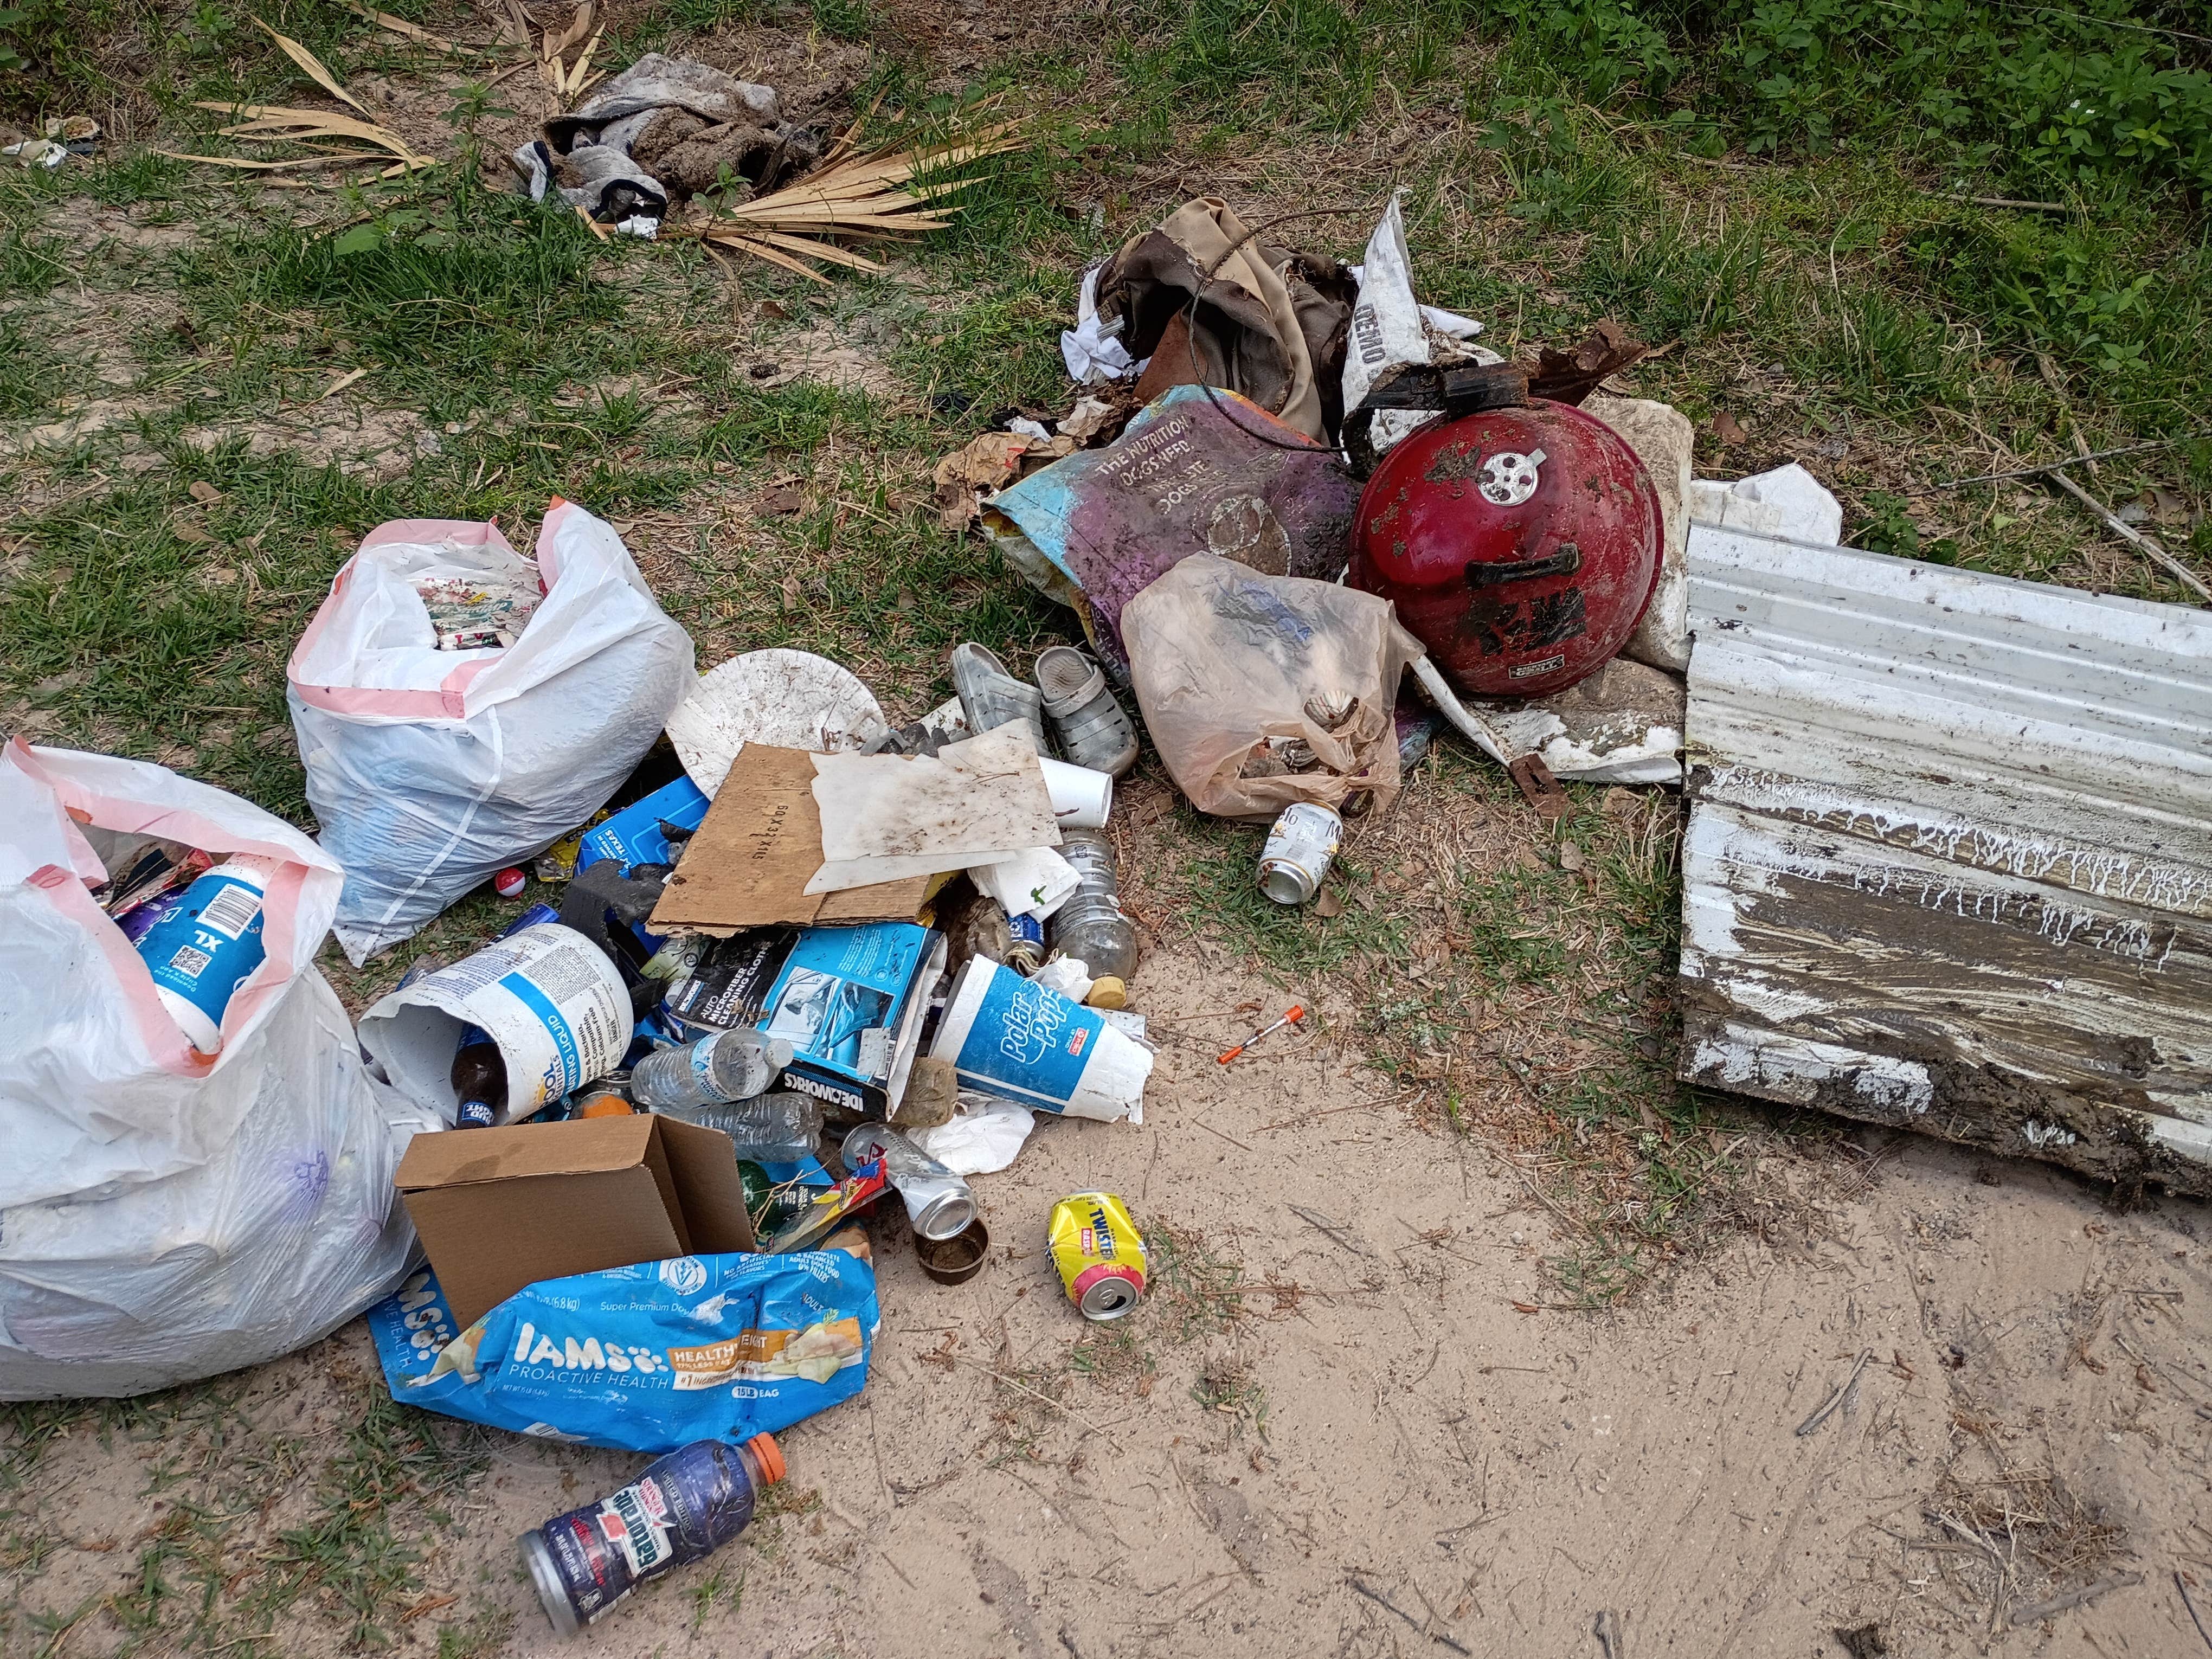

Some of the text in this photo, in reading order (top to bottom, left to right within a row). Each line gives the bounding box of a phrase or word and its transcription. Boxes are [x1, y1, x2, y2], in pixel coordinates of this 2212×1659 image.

[1095, 452, 1129, 474] THE
[1125, 415, 1188, 459] NUTRITION
[1120, 456, 1159, 486] DOGS
[776, 805, 788, 816] 60
[605, 829, 626, 855] TEXAS
[762, 839, 771, 848] X
[194, 930, 224, 953] XL
[700, 995, 719, 1019] AUTO
[708, 967, 747, 1023] MICROFIBER
[718, 978, 749, 1025] CLEANING
[583, 1013, 598, 1060] Compatible,
[589, 1006, 605, 1056] Calcium-Free
[1000, 992, 1032, 1063] Polar
[1030, 992, 1068, 1048] Pop
[548, 1015, 577, 1095] NATING LIQUID
[578, 1024, 590, 1058] Bacteria,
[553, 1055, 564, 1101] SENTIALS
[724, 1254, 775, 1276] NO ARTIFICIAL
[789, 1256, 840, 1279] ADULT DOG FOOD
[803, 1252, 835, 1267] BALANCED
[808, 1251, 840, 1263] MPLETE
[809, 1265, 830, 1284] FILLERS
[396, 1273, 443, 1329] MS
[600, 1301, 628, 1312] Super
[629, 1302, 670, 1313] Premium
[390, 1319, 412, 1369] HEALTH
[513, 1322, 632, 1372] IAMS
[508, 1364, 604, 1385] PROACTIVE
[607, 1373, 670, 1390] HEALTH
[681, 1374, 693, 1387] #1
[759, 1388, 780, 1398] BAG
[642, 1479, 665, 1515] STRANGER
[674, 1496, 692, 1532] EDITION
[613, 1490, 659, 1568] Gatorade
